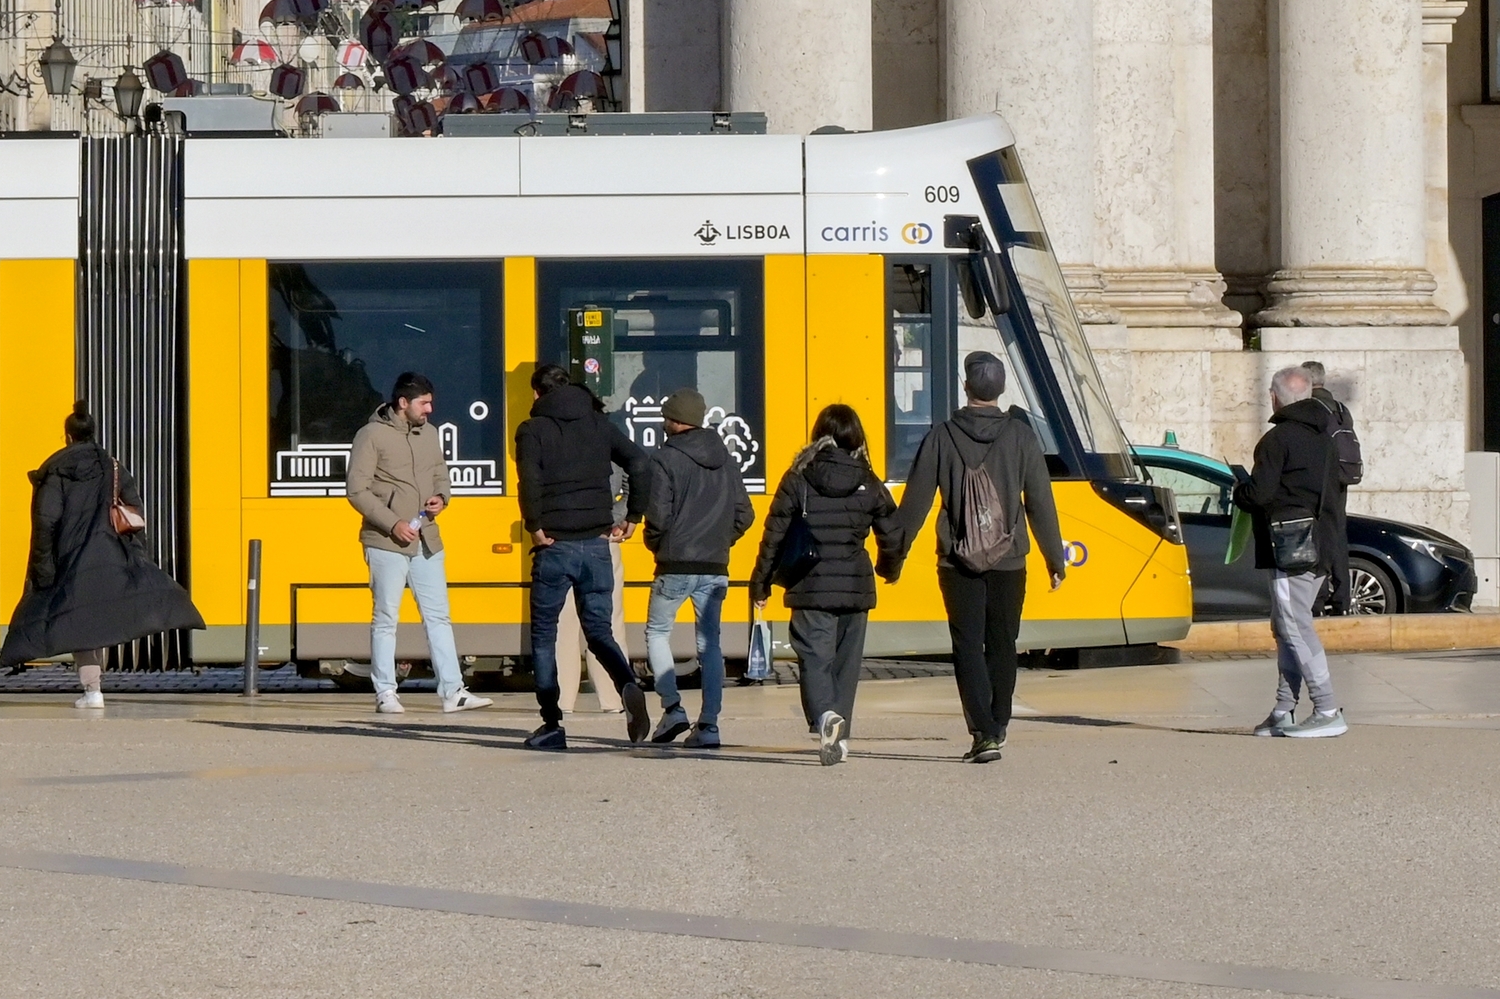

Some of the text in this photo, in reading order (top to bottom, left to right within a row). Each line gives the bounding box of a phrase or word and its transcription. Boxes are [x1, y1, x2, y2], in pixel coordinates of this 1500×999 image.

[924, 185, 960, 203] 609
[726, 225, 791, 240] LISBOA
[821, 220, 889, 242] carris
